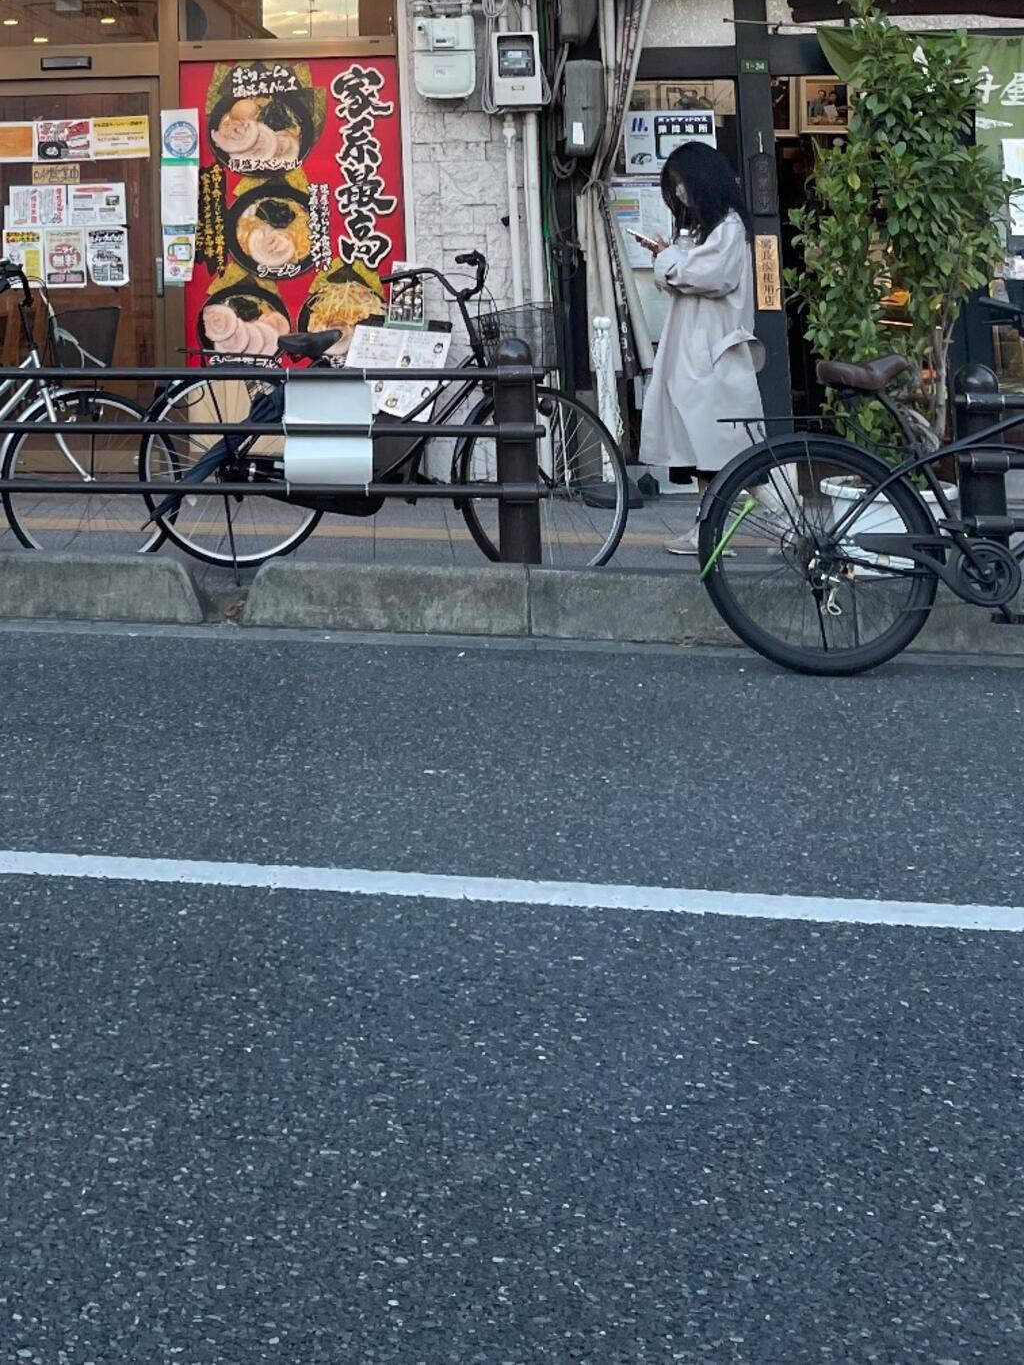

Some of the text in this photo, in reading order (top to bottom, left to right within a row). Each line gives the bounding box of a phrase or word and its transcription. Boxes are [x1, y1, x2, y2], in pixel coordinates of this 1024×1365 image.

[232, 65, 289, 85] ボリューム
[331, 64, 397, 269] 家系最高
[257, 262, 301, 277] ラーメン
